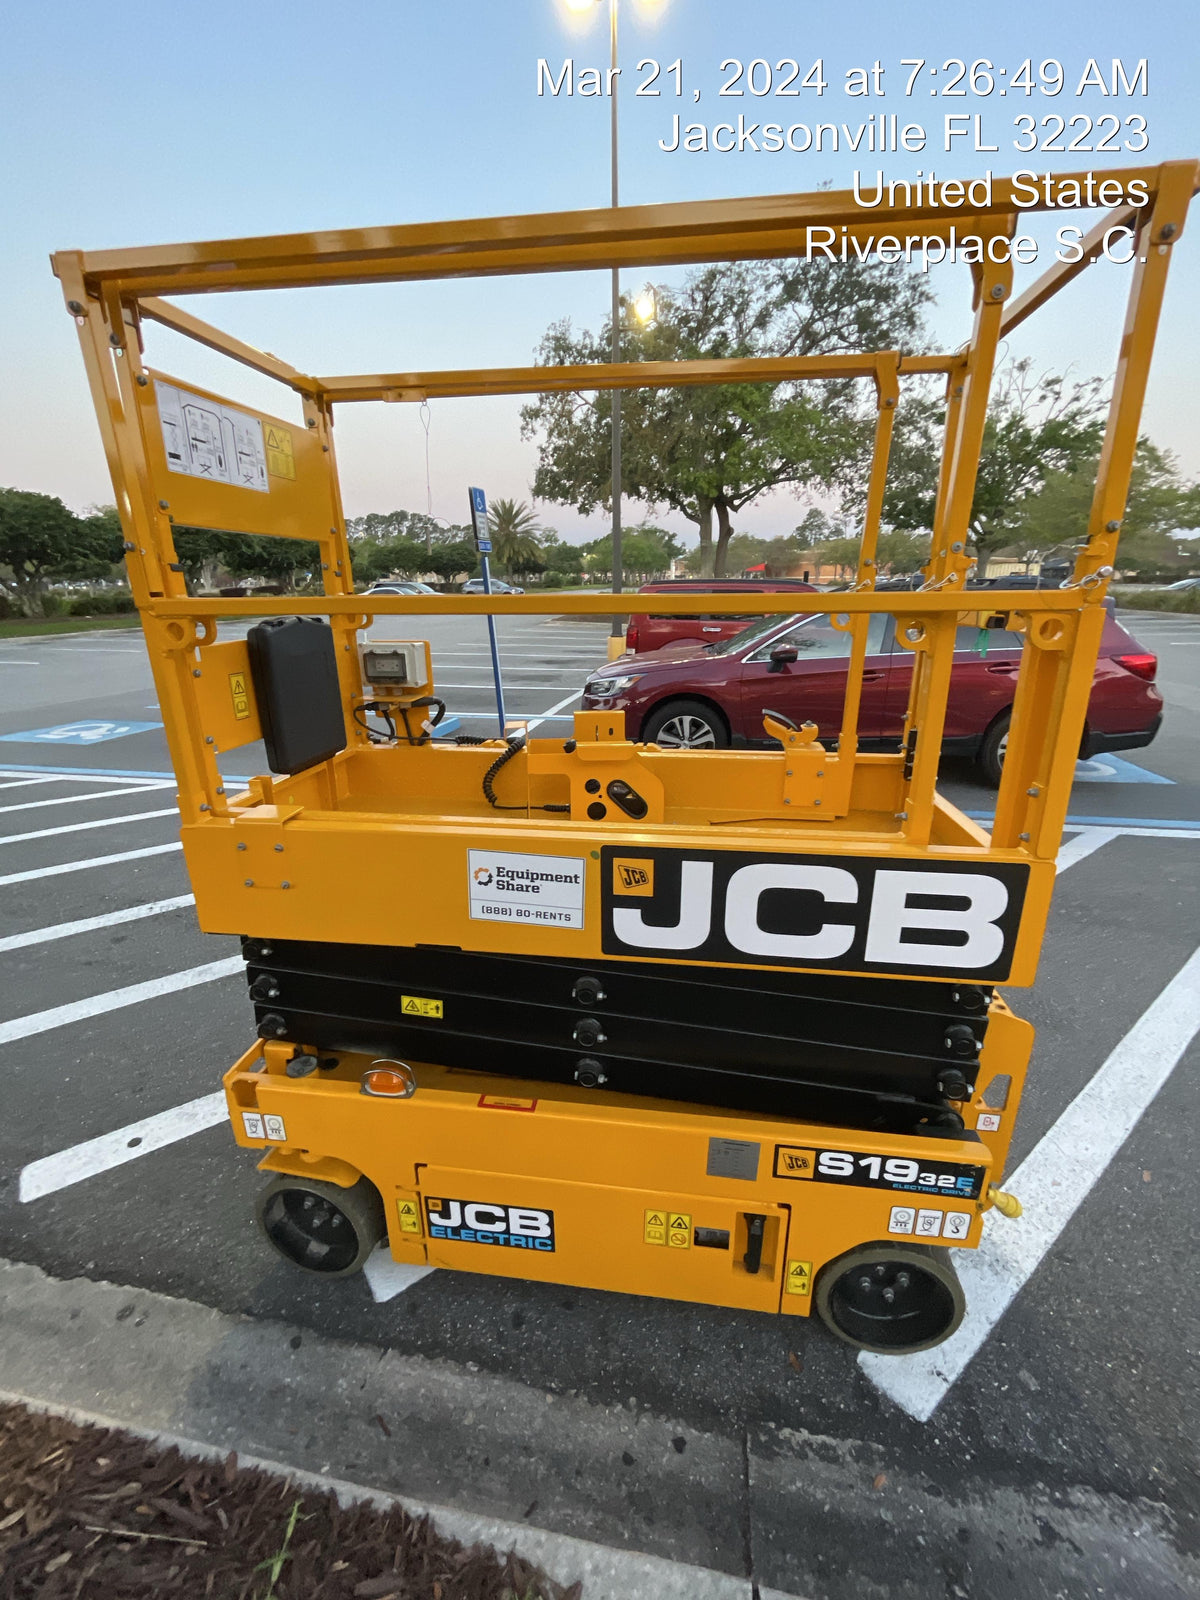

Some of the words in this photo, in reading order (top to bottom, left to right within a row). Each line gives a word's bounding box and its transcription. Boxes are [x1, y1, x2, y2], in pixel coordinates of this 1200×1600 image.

[496, 866, 580, 884] Equipment
[623, 867, 647, 886] JCB
[496, 879, 541, 893] Share
[481, 905, 512, 917] (888)
[516, 908, 572, 922] 80-RENTS
[612, 860, 1009, 969] JCB
[788, 1154, 808, 1169] JCB
[892, 1183, 939, 1193] ELECTRIC
[941, 1187, 972, 1197] DRIVE
[428, 1200, 552, 1238] JCB
[430, 1225, 552, 1251] ELECTRIC
